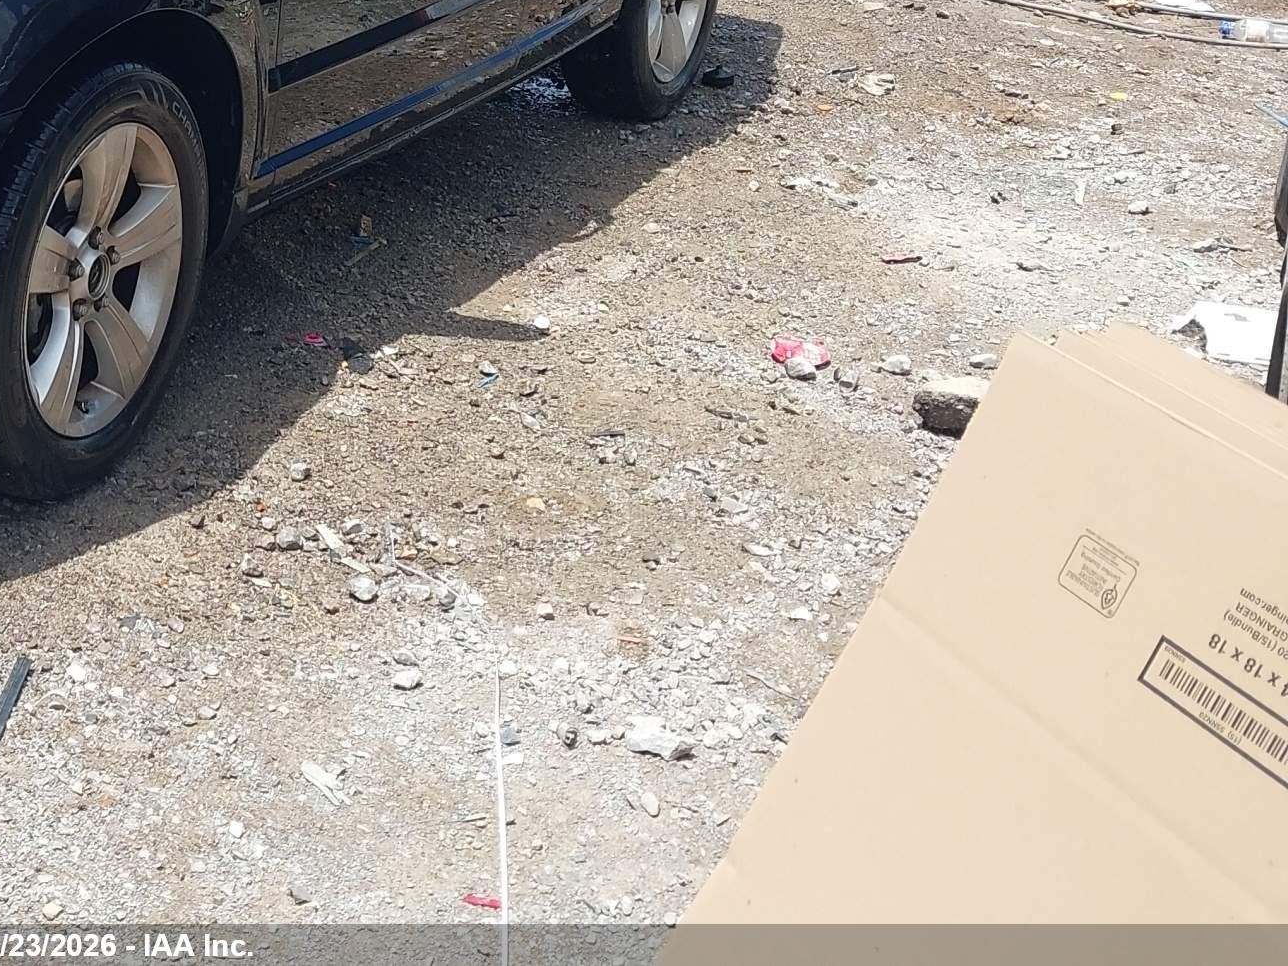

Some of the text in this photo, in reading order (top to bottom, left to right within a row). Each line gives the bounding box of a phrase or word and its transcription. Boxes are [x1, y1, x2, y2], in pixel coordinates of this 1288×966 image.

[1223, 609, 1278, 652] (15/Bundle)
[1235, 601, 1288, 641] GRAINGER
[1208, 633, 1228, 654] 18
[1230, 645, 1244, 662] x
[1243, 657, 1263, 678] 18
[1267, 671, 1281, 687] x
